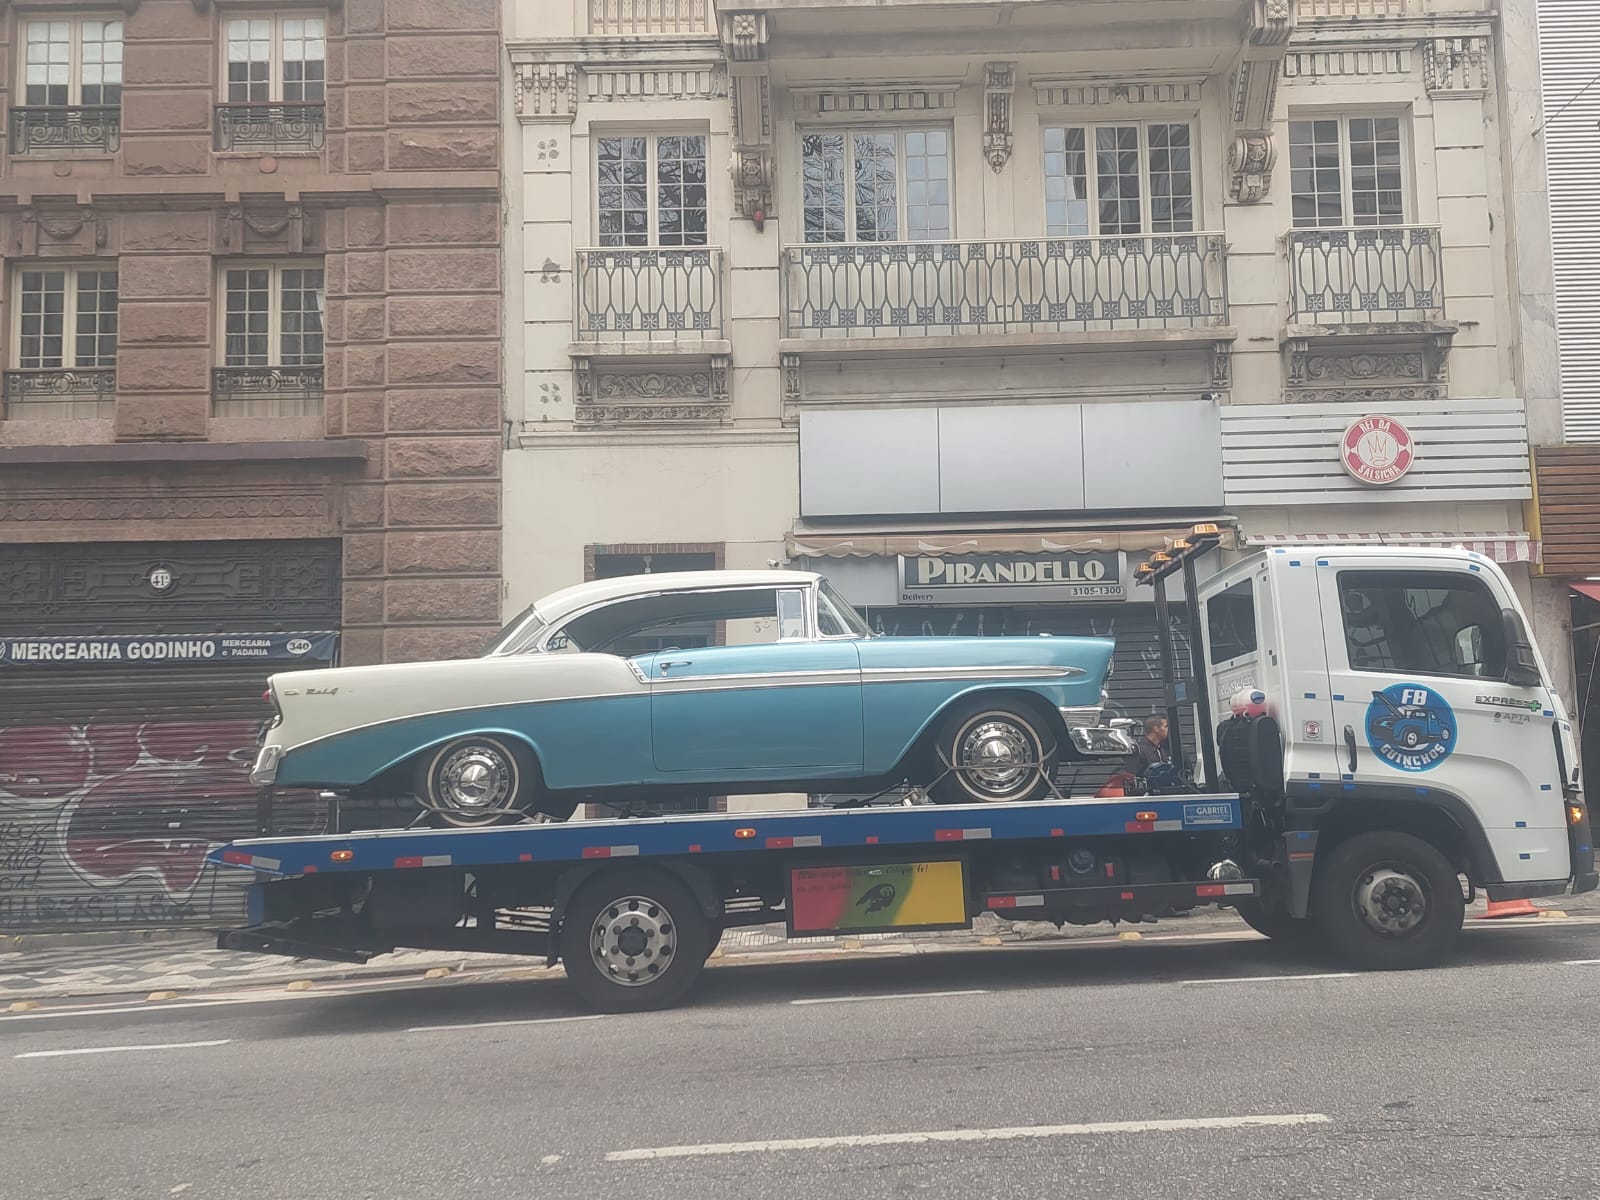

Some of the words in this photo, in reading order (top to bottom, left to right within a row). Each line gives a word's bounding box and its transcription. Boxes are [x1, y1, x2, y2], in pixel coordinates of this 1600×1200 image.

[1359, 419, 1374, 433] REI
[1378, 419, 1391, 432] DA
[1358, 464, 1401, 480] SALSICHA
[1072, 586, 1122, 596] 3105-1300
[902, 592, 934, 602] Delivery
[222, 639, 271, 647] MERCEARIA
[289, 642, 309, 651] 340
[11, 642, 122, 660] MERCEARIA
[126, 640, 215, 659] GODINHO
[231, 648, 268, 656] PADARIA
[1401, 688, 1428, 706] FB
[1380, 743, 1446, 766] GUINCHOS
[1196, 806, 1229, 815] GABRIEL
